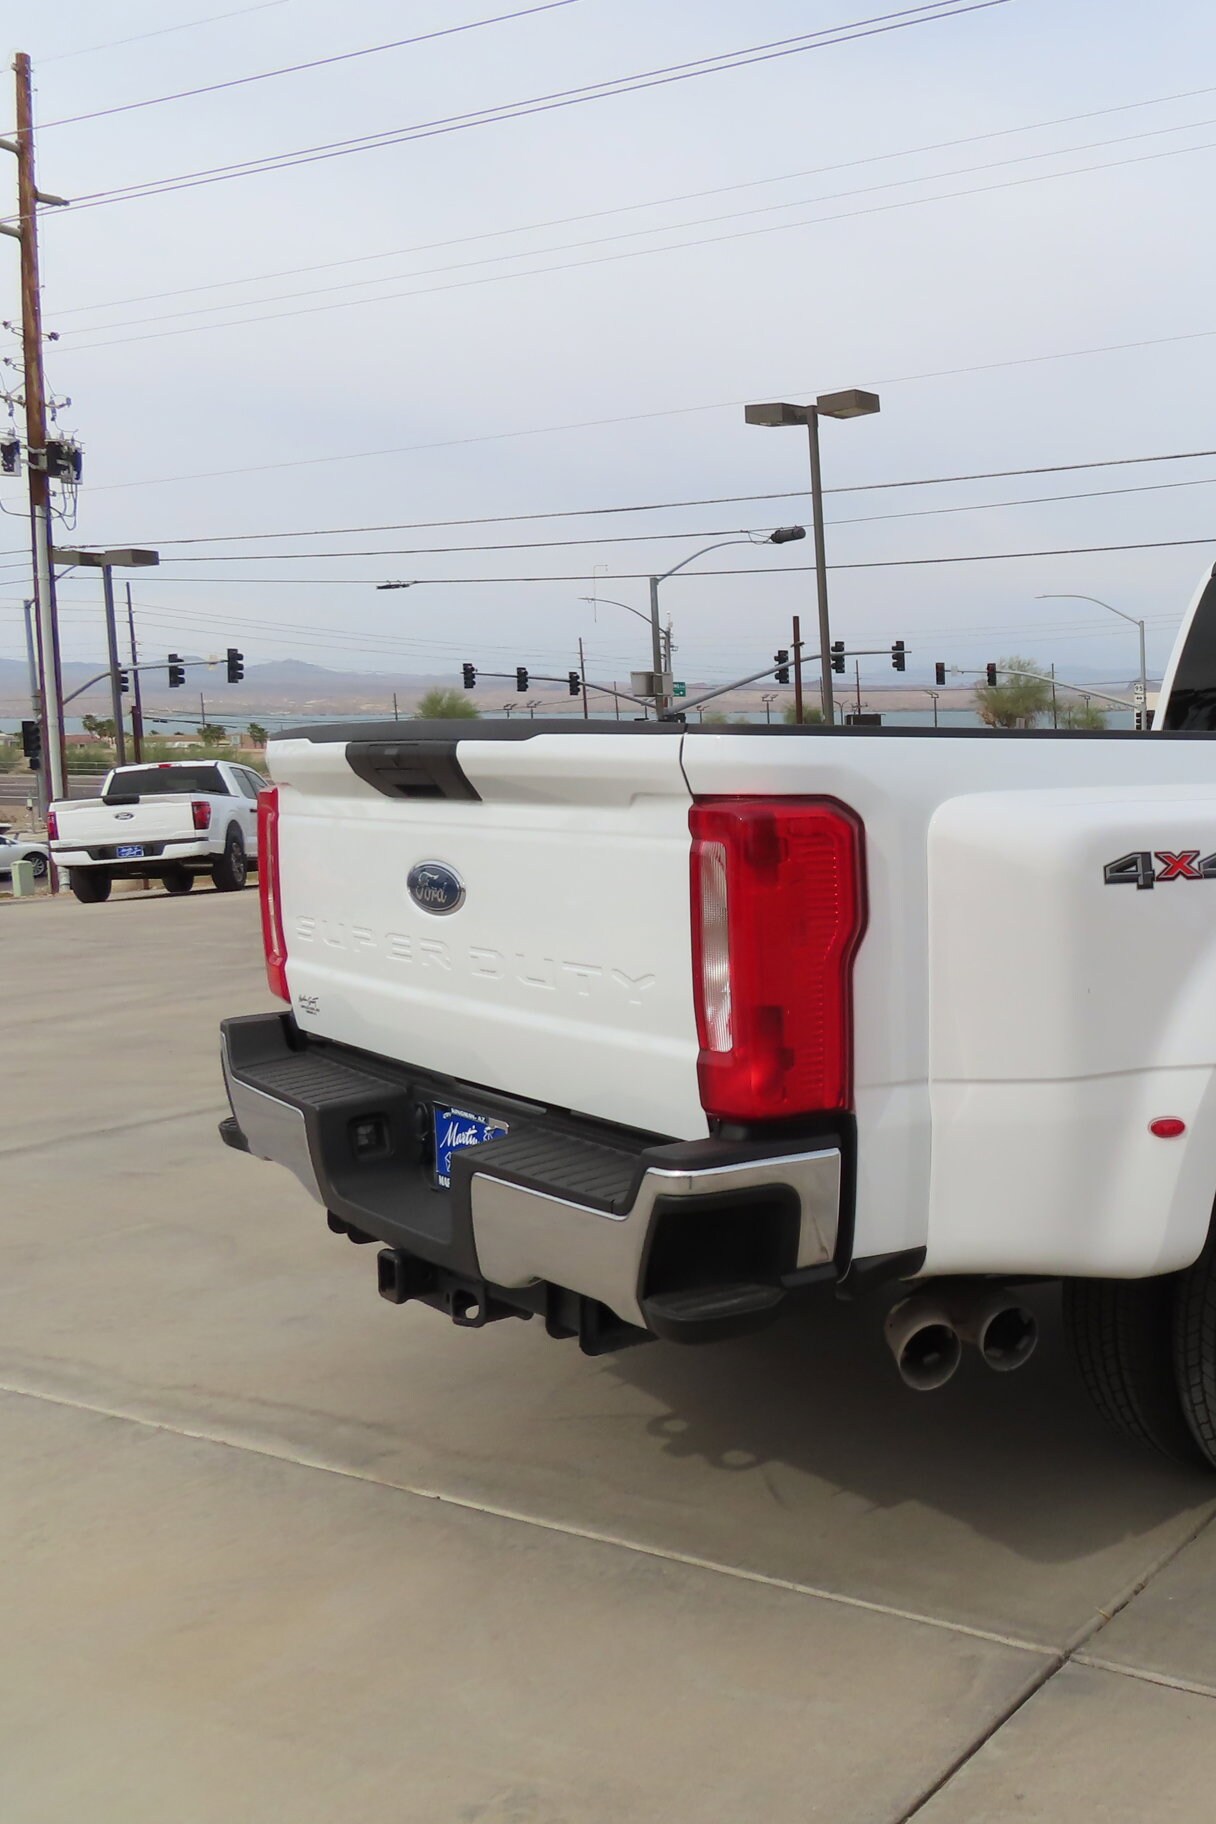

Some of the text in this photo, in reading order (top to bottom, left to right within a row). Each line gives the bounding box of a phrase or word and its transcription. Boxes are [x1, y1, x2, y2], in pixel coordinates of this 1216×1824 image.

[415, 871, 447, 903] Ford
[296, 915, 656, 1005] SUPER DUTY
[440, 1121, 478, 1149] Martin
